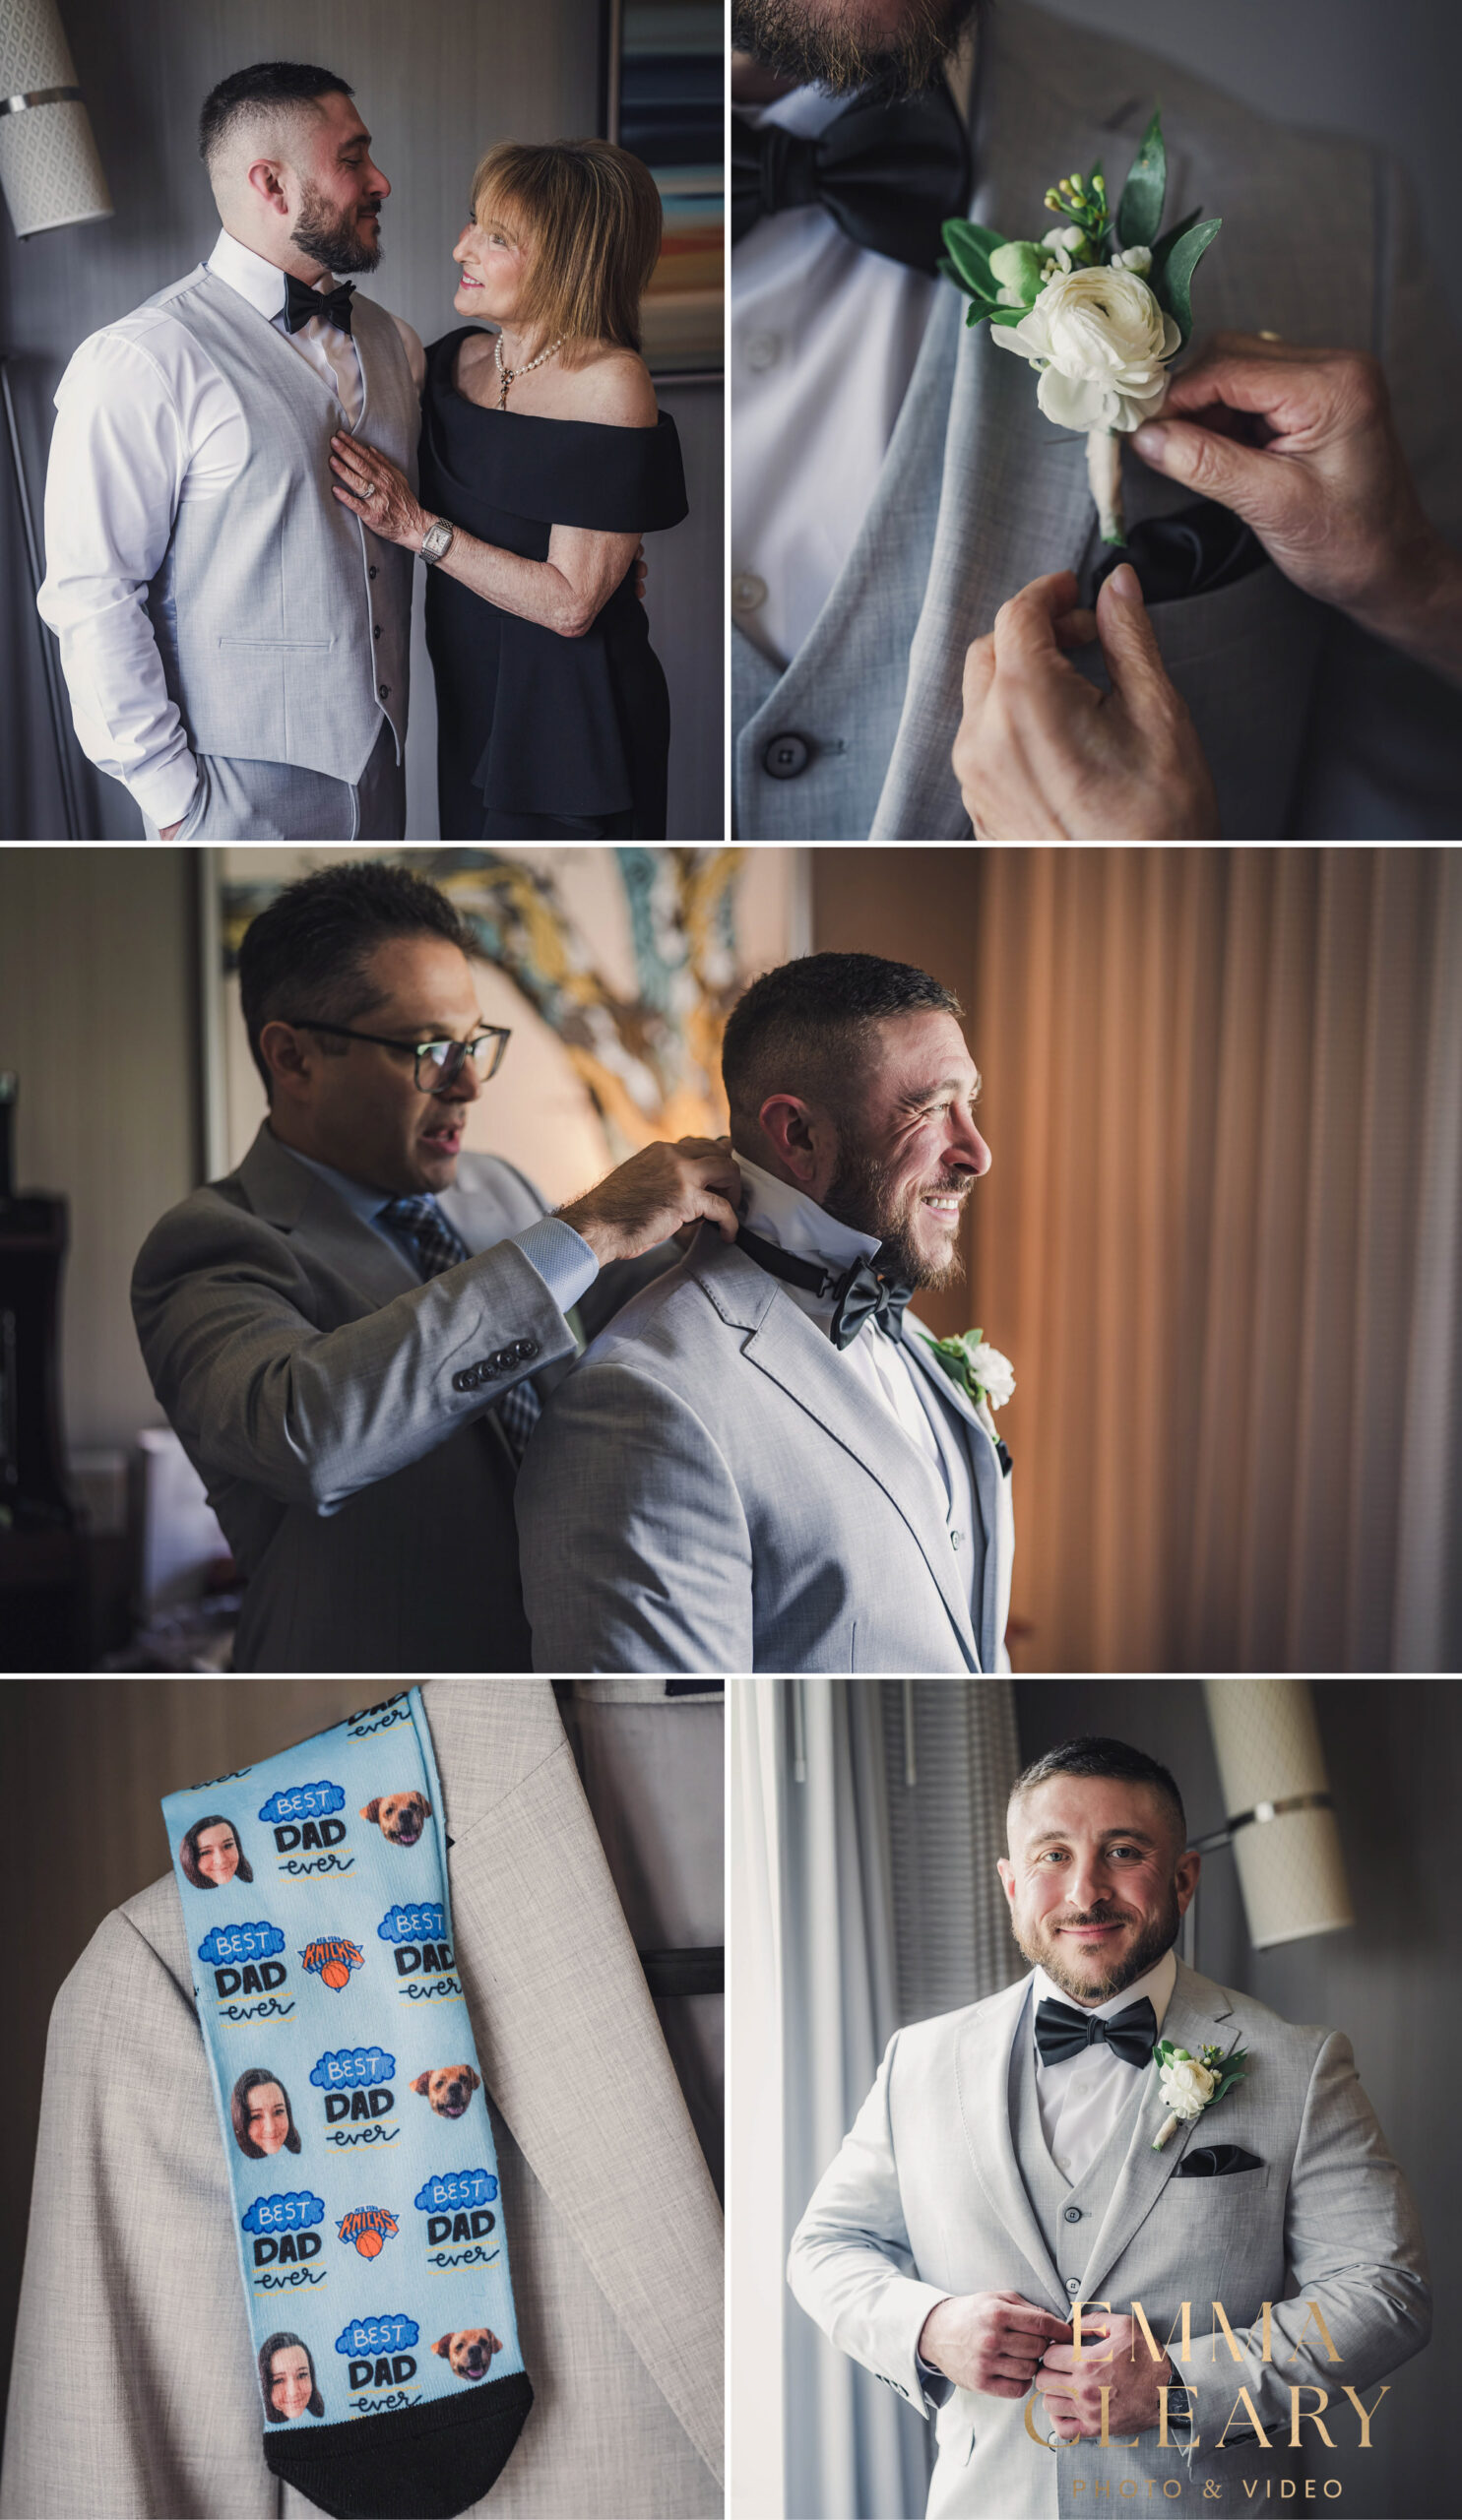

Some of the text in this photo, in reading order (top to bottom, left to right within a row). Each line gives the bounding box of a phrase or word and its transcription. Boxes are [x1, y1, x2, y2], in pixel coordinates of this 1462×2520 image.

[347, 1709, 413, 1736] ever
[277, 1789, 331, 1815] BEST
[274, 1818, 347, 1853] DAD
[279, 1858, 354, 1875] ever
[397, 1913, 443, 1933] BEST
[216, 1931, 269, 1956] BEST
[303, 1940, 364, 1969] KNICKS
[214, 1961, 287, 1998] DAD
[220, 1998, 295, 2021] ever
[328, 2056, 380, 2081] BEST
[324, 2088, 394, 2123] DAD
[326, 2124, 400, 2146] ever
[433, 2178, 484, 2204] BEST
[258, 2201, 311, 2225] BEST
[339, 2209, 399, 2239] KNICKS
[427, 2209, 496, 2245] DAD
[253, 2231, 322, 2266] DAD
[427, 2245, 500, 2268] ever
[254, 2268, 327, 2290] ever
[353, 2324, 405, 2348] BEST
[348, 2355, 417, 2390] DAD
[350, 2391, 423, 2413] ever
